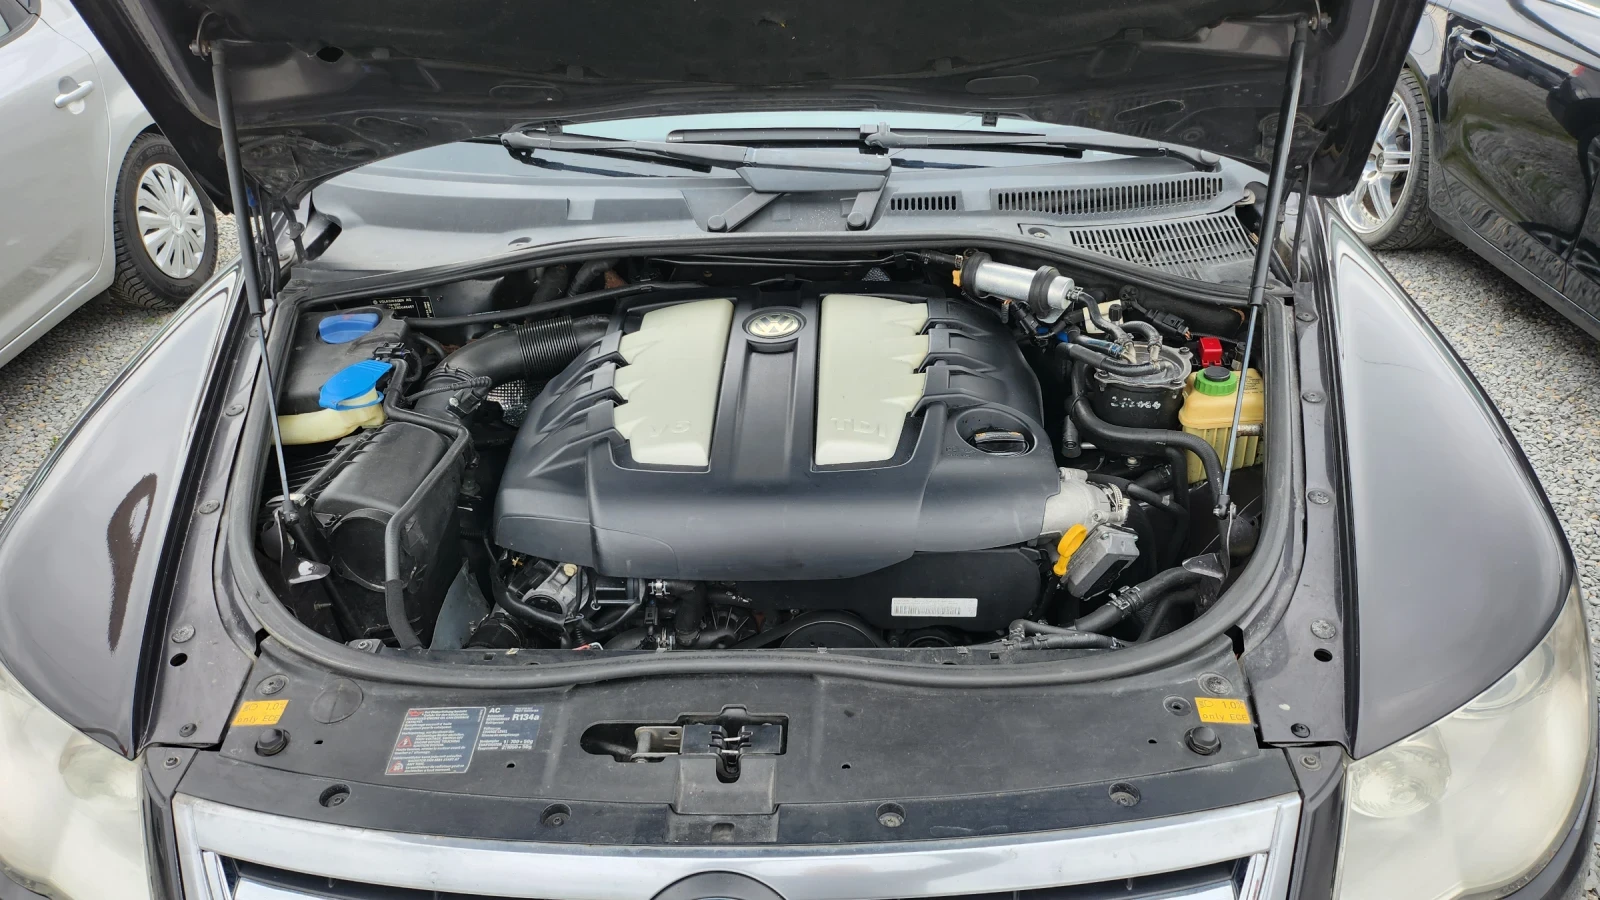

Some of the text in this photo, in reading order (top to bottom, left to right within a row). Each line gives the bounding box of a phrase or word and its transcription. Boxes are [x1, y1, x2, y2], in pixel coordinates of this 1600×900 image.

[829, 416, 886, 438] TDI
[237, 714, 280, 724] only ECE
[512, 713, 540, 721] R134a
[1202, 712, 1248, 721] only ECE
